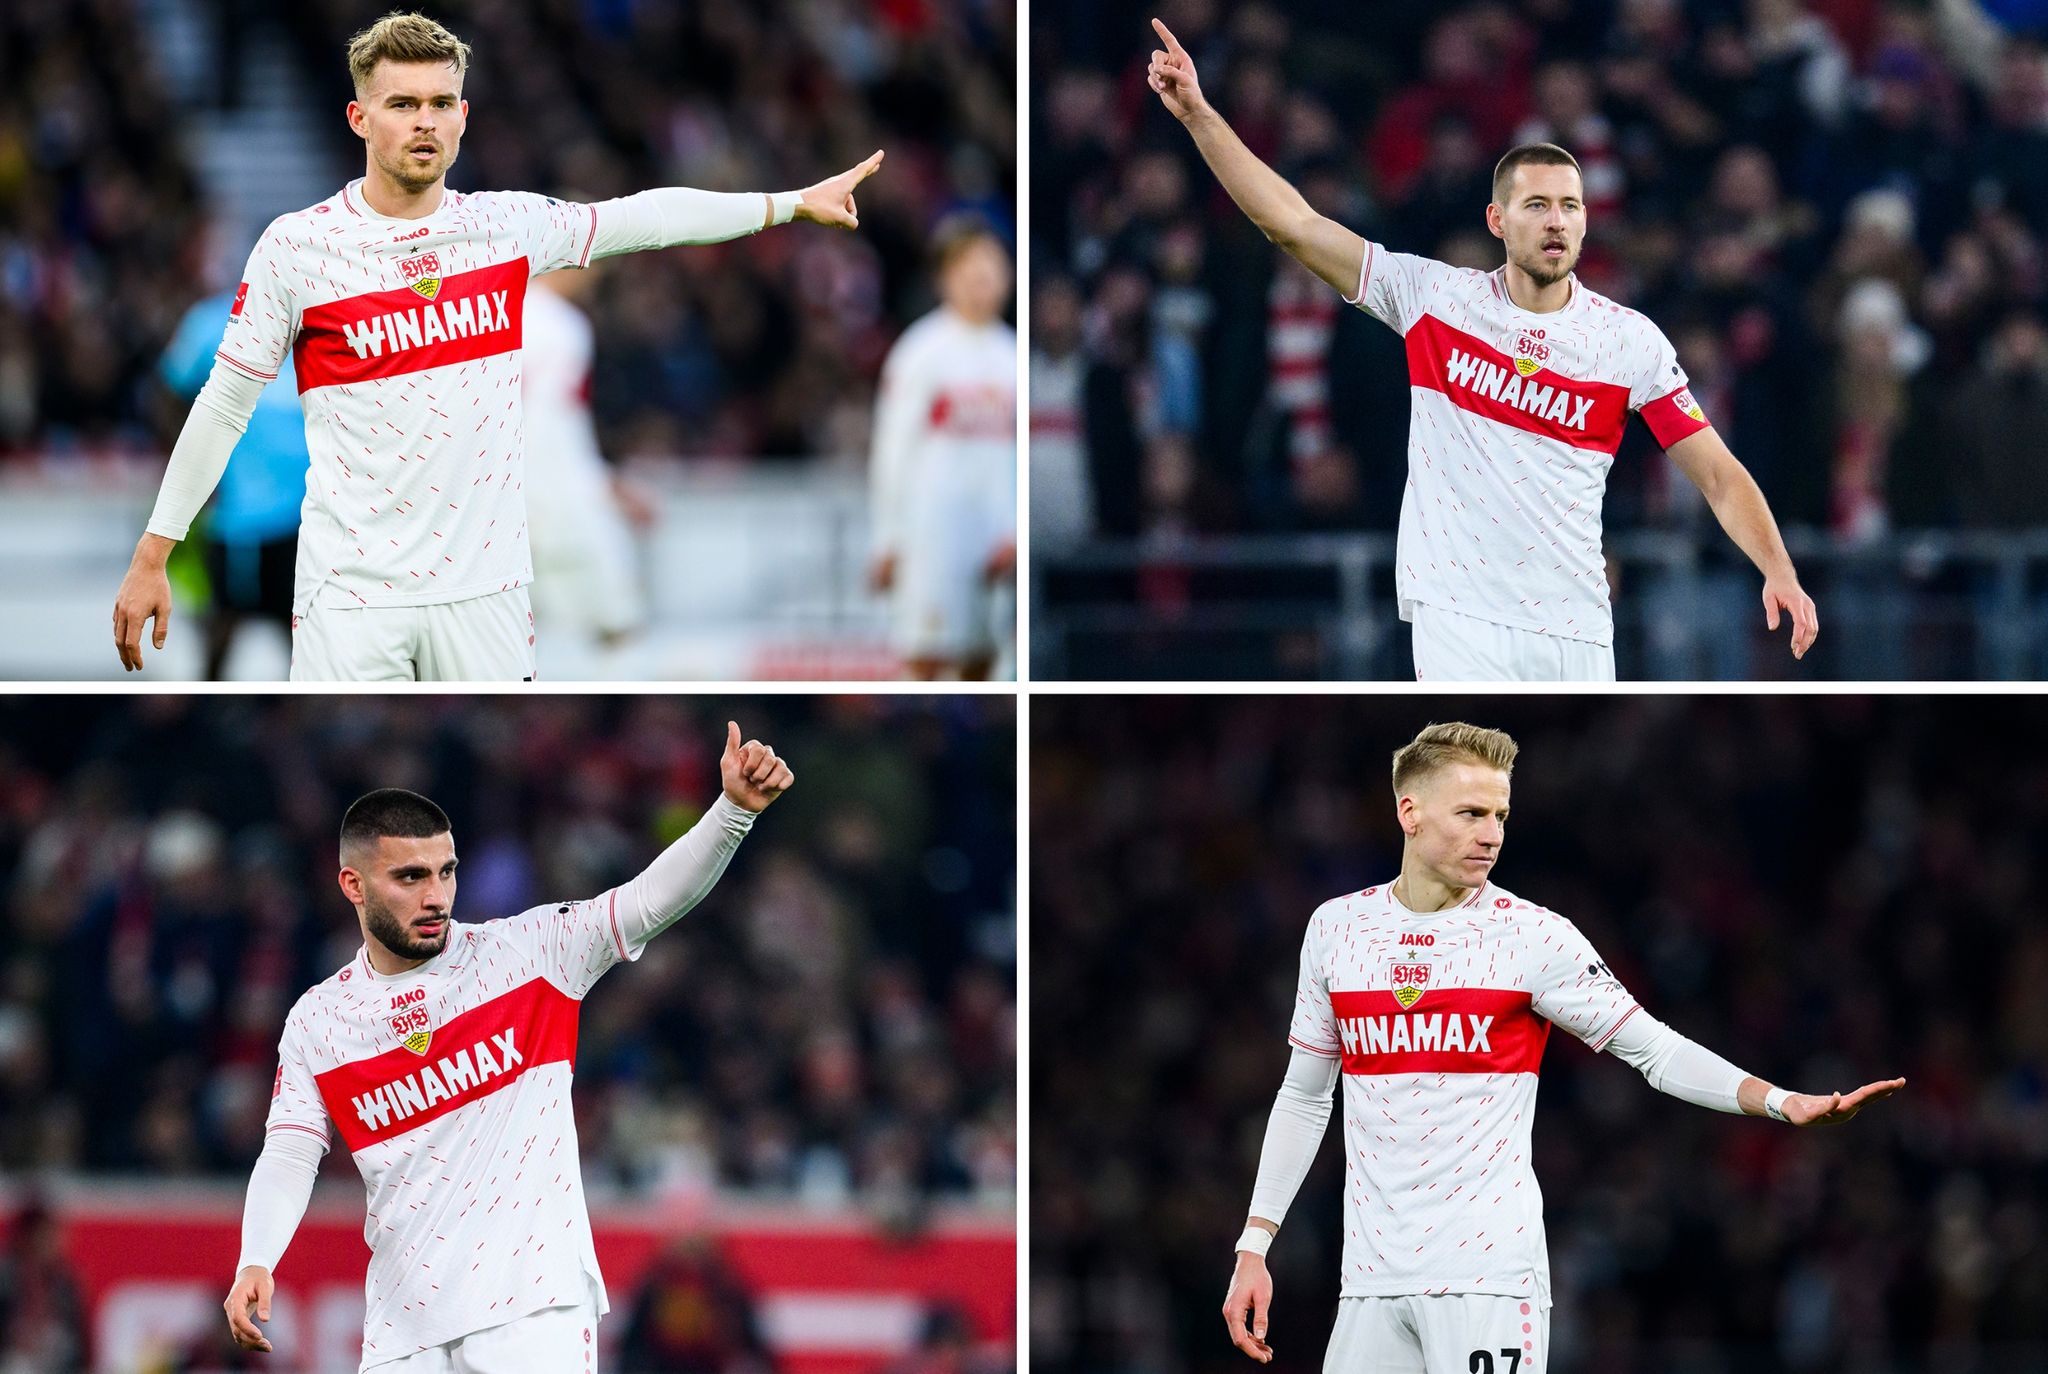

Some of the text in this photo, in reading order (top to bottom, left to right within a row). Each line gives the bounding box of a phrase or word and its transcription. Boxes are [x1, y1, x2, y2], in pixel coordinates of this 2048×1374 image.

[393, 227, 430, 242] JAKO
[342, 290, 510, 359] WINAMAX
[1447, 348, 1594, 431] WINAMAX
[1399, 933, 1435, 947] JAKO
[390, 988, 426, 1010] JAKO
[1336, 1014, 1494, 1055] WINAMAX
[352, 1027, 523, 1132] WINAMAX
